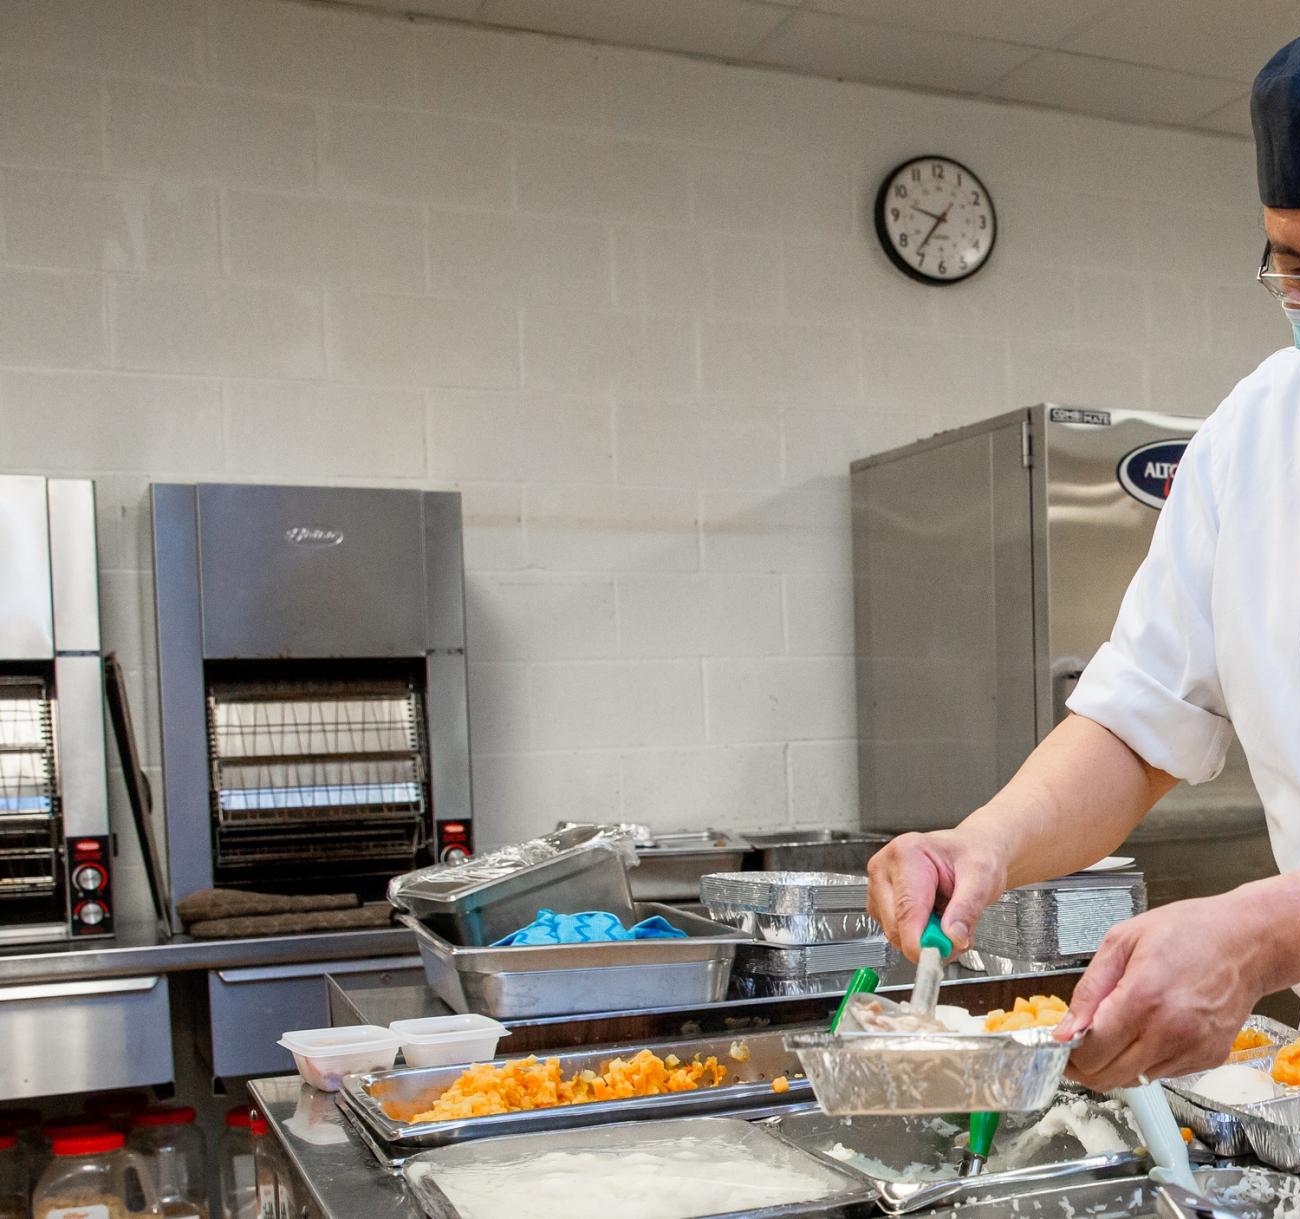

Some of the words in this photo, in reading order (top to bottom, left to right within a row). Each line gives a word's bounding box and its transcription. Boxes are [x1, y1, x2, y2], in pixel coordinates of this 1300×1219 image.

[912, 168, 921, 182] 11
[932, 164, 943, 179] 12
[957, 173, 962, 187] 1
[895, 184, 907, 198] 10
[972, 190, 980, 206] 2
[891, 207, 899, 222] 9
[980, 215, 987, 230] 3
[899, 233, 908, 248] 8
[916, 251, 925, 268] 7
[960, 256, 968, 270] 5
[938, 260, 947, 275] 6
